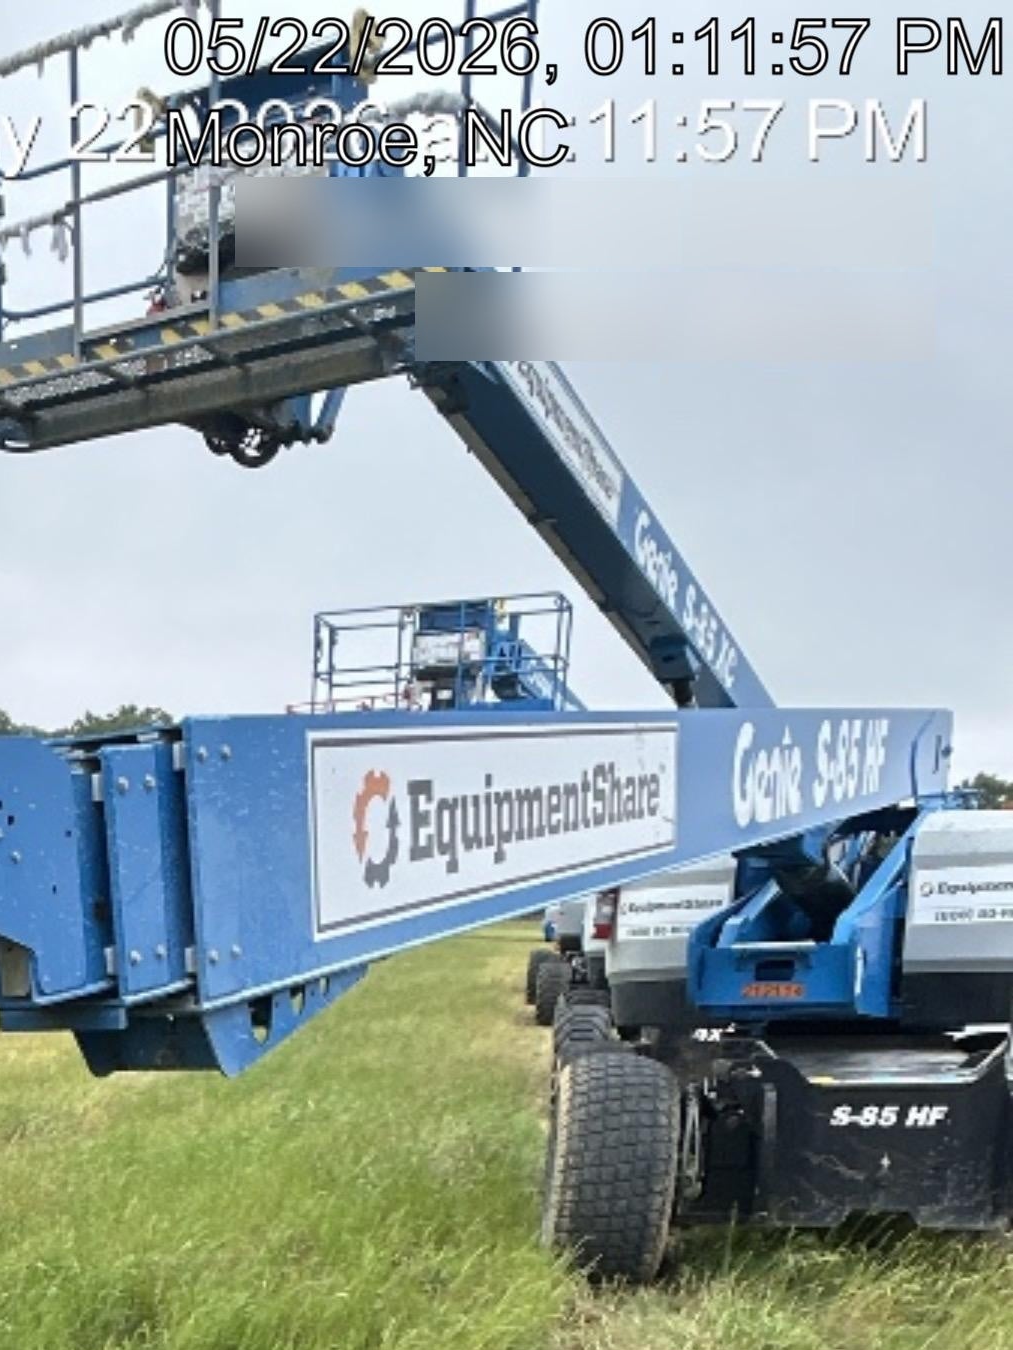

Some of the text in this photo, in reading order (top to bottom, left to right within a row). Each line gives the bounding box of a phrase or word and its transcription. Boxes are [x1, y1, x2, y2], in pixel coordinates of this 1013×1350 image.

[634, 510, 678, 612] Genie
[406, 760, 660, 874] EquipmentShare
[732, 718, 890, 829] Genie S-85 HF
[829, 1104, 949, 1128] S-85 HF
